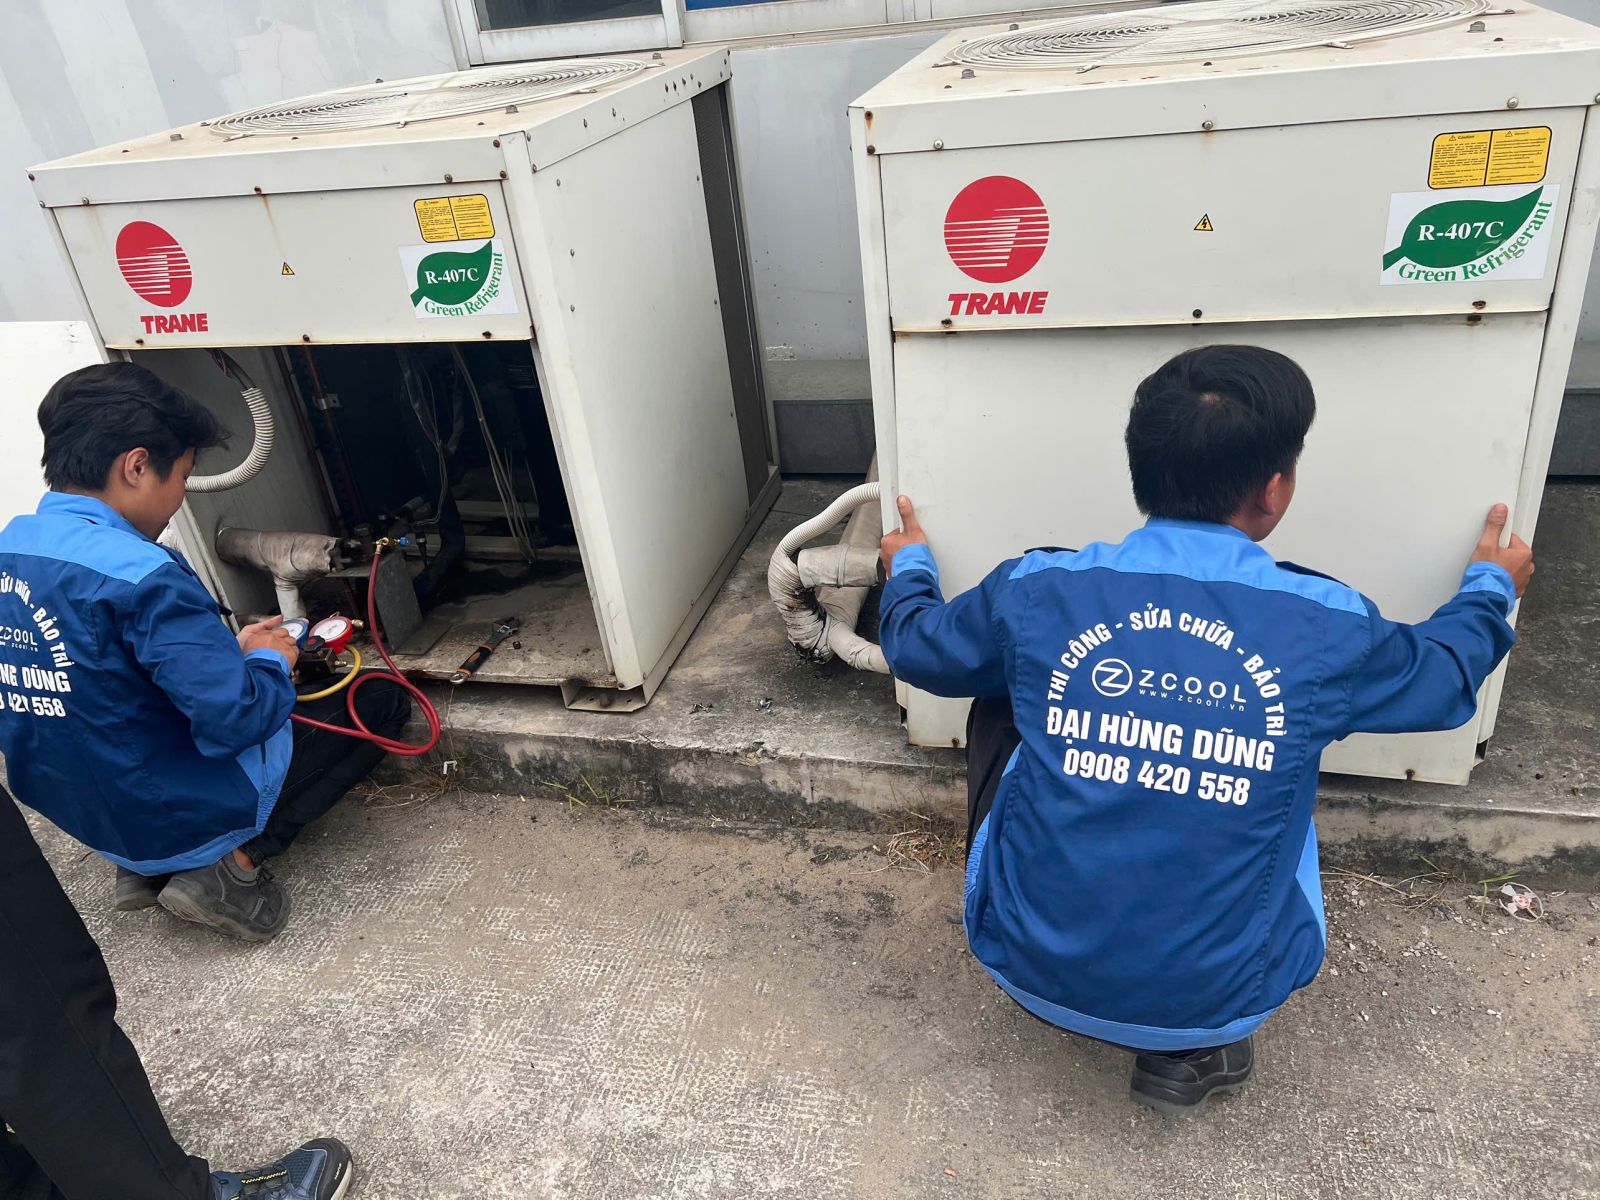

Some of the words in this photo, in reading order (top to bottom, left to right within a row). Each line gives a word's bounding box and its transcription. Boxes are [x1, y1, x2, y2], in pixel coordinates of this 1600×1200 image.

[1398, 263, 1456, 282] Green
[1462, 200, 1553, 280] Refrigerant
[1417, 221, 1504, 242] R-407C
[424, 267, 480, 284] R-407C
[424, 301, 464, 317] Green
[464, 252, 503, 315] Refrigerant
[948, 291, 1049, 316] TRANE
[140, 313, 208, 334] TRANE
[32, 606, 60, 641] BẢO
[50, 641, 75, 668] TRÌ
[22, 664, 71, 692] DŨNG
[1047, 669, 1070, 701] THI
[1060, 623, 1112, 669] CÔNG
[1129, 602, 1172, 631] SỬA
[1179, 612, 1234, 651] CHỮA
[1243, 653, 1281, 698] BẢO
[1265, 701, 1287, 736] TRÌ
[1138, 669, 1247, 703] ZCOOL
[1139, 688, 1245, 712] www.zcool.vn
[31, 696, 66, 717] 558
[1046, 706, 1091, 744] ĐẠI
[1099, 711, 1184, 755] HÙNG
[1192, 727, 1275, 771] DŨNG
[1063, 748, 1130, 784] 0908
[1137, 760, 1191, 794] 420
[1197, 771, 1251, 806] 558
